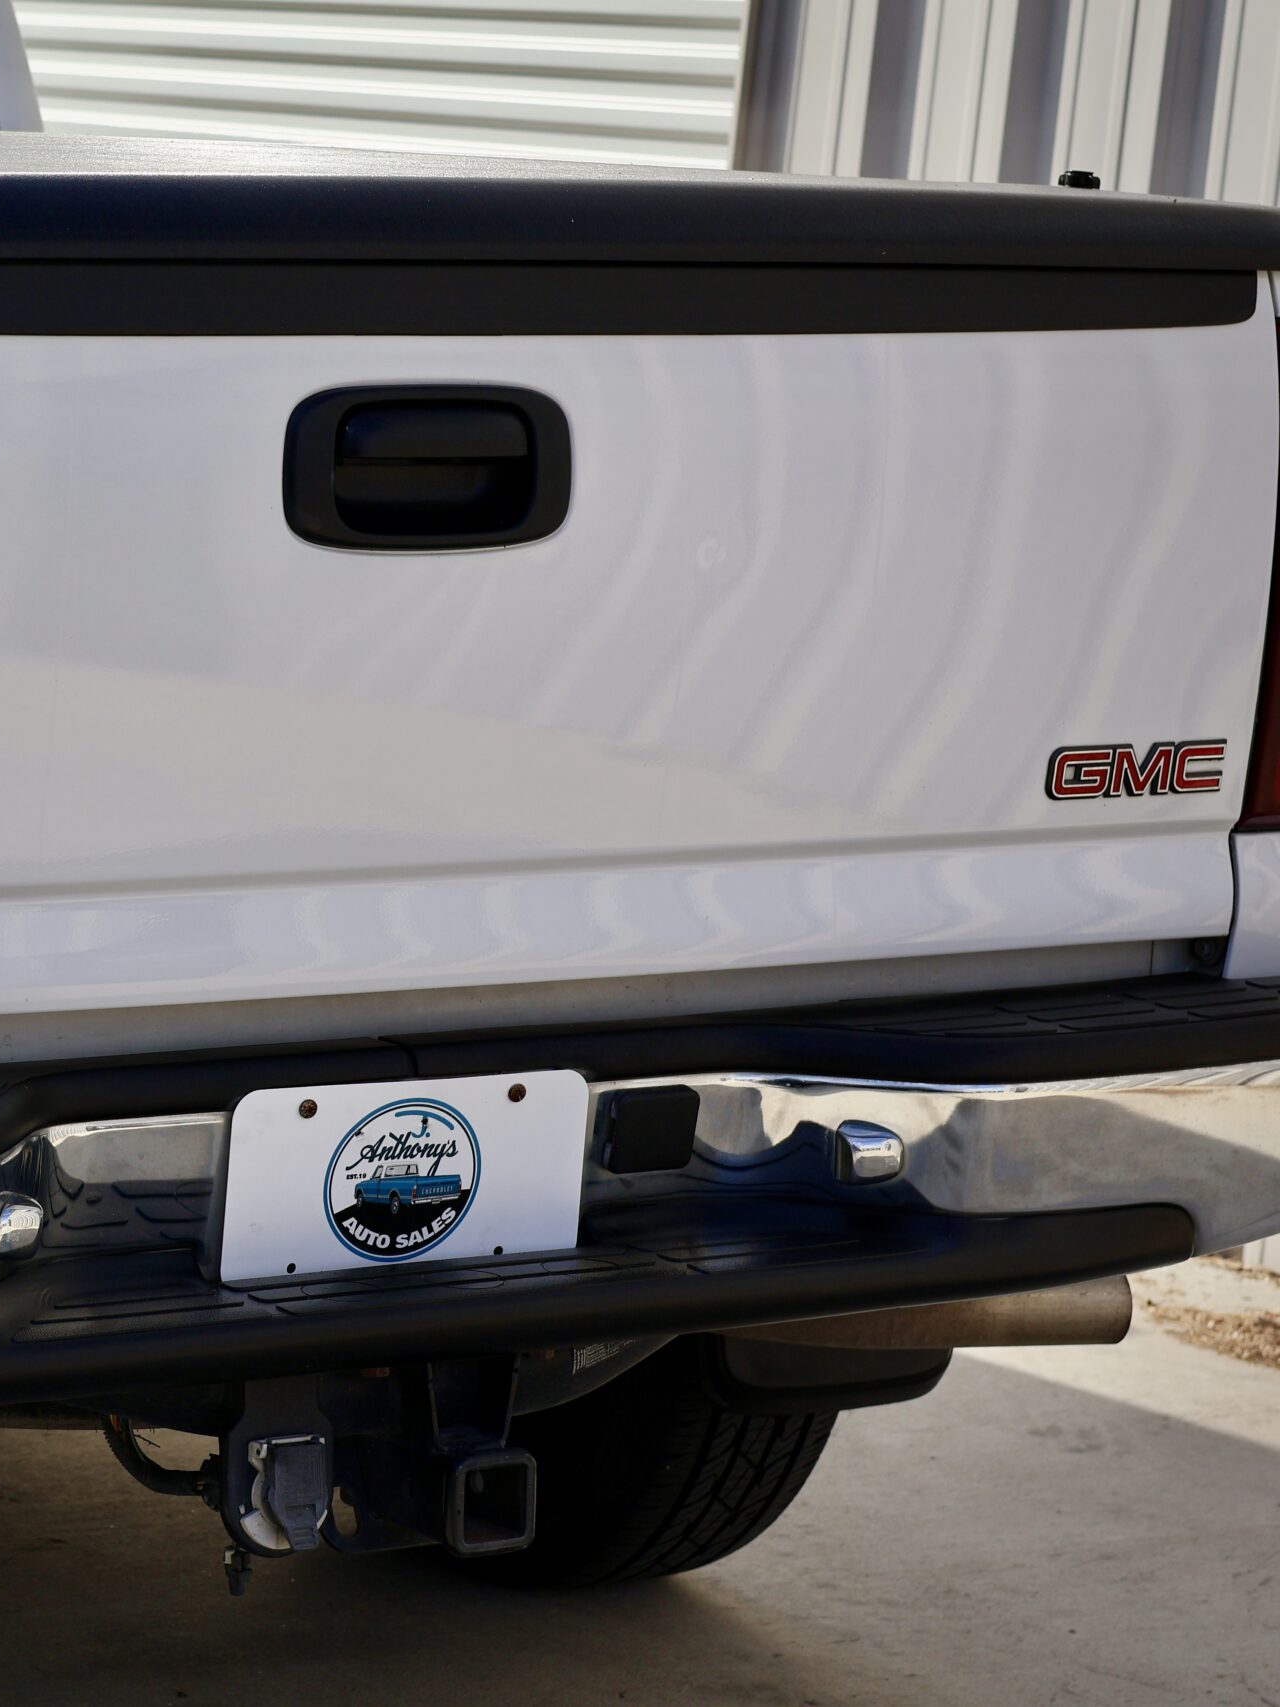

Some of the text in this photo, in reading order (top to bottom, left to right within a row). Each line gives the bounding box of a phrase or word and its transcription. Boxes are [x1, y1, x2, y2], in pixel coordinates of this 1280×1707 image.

[1045, 738, 1228, 801] GMC
[345, 1131, 458, 1177] Anthony's
[341, 1206, 457, 1249] AUTO SALES
